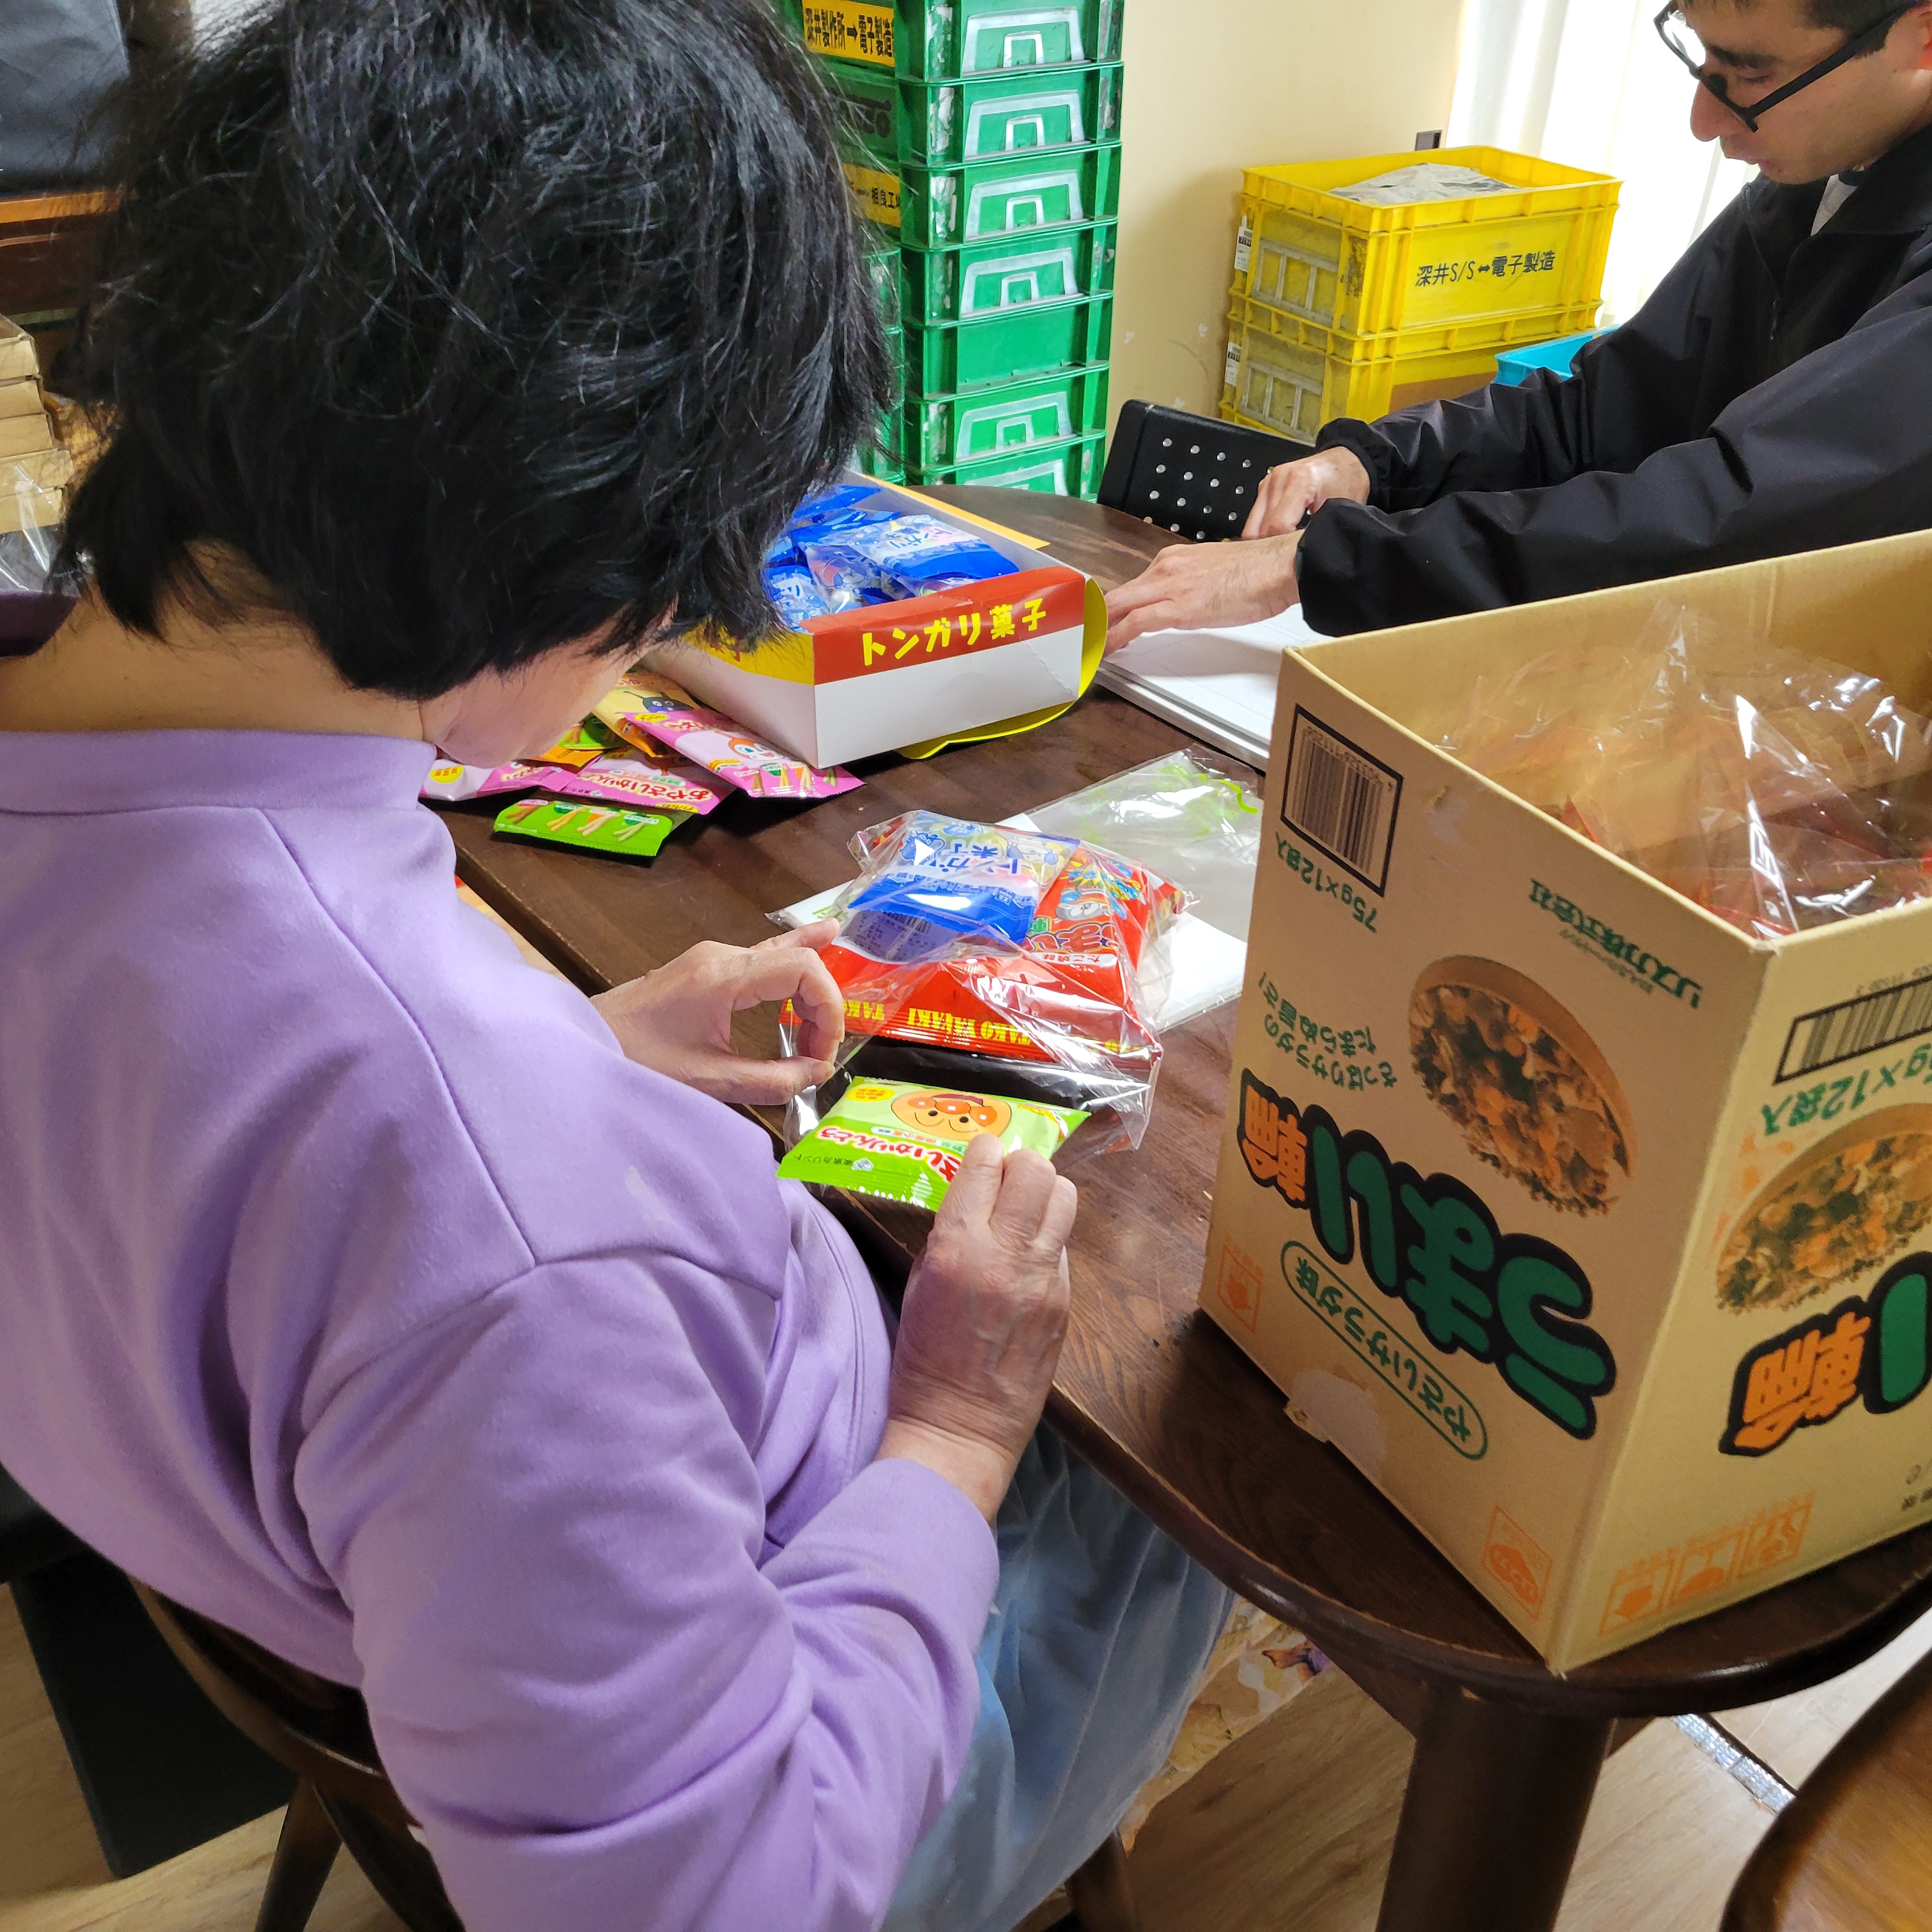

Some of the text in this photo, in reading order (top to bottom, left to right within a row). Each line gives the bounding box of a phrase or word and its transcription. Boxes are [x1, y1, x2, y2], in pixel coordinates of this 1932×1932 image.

[862, 598, 1046, 666] トンガリ菓子
[1238, 1070, 1615, 1439] うまい輪
[1296, 1257, 1472, 1443] やさいサラダ味
